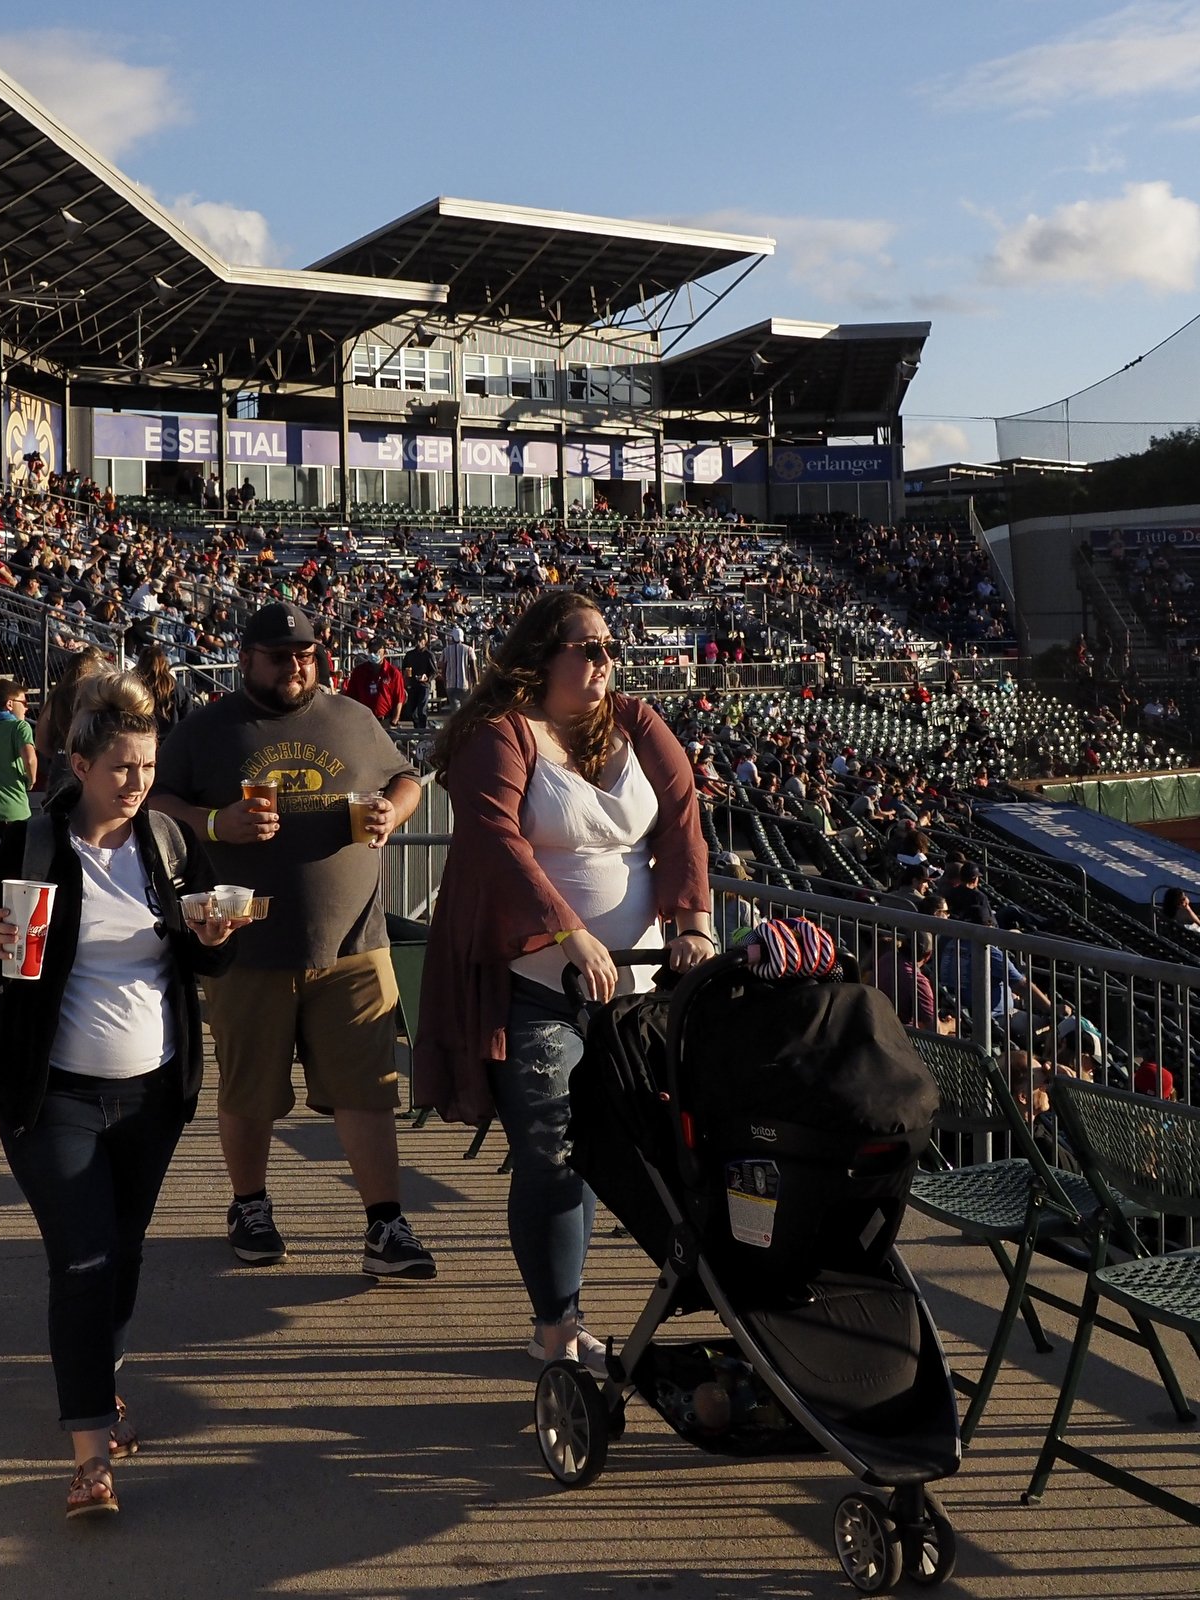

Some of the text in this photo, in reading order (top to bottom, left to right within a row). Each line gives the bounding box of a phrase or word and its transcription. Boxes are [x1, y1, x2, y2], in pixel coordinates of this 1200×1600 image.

[806, 454, 883, 476] erlanger
[1135, 530, 1178, 544] Little
[240, 742, 345, 778] MICHIGAN
[281, 769, 311, 791] M
[750, 1124, 777, 1137] britax
